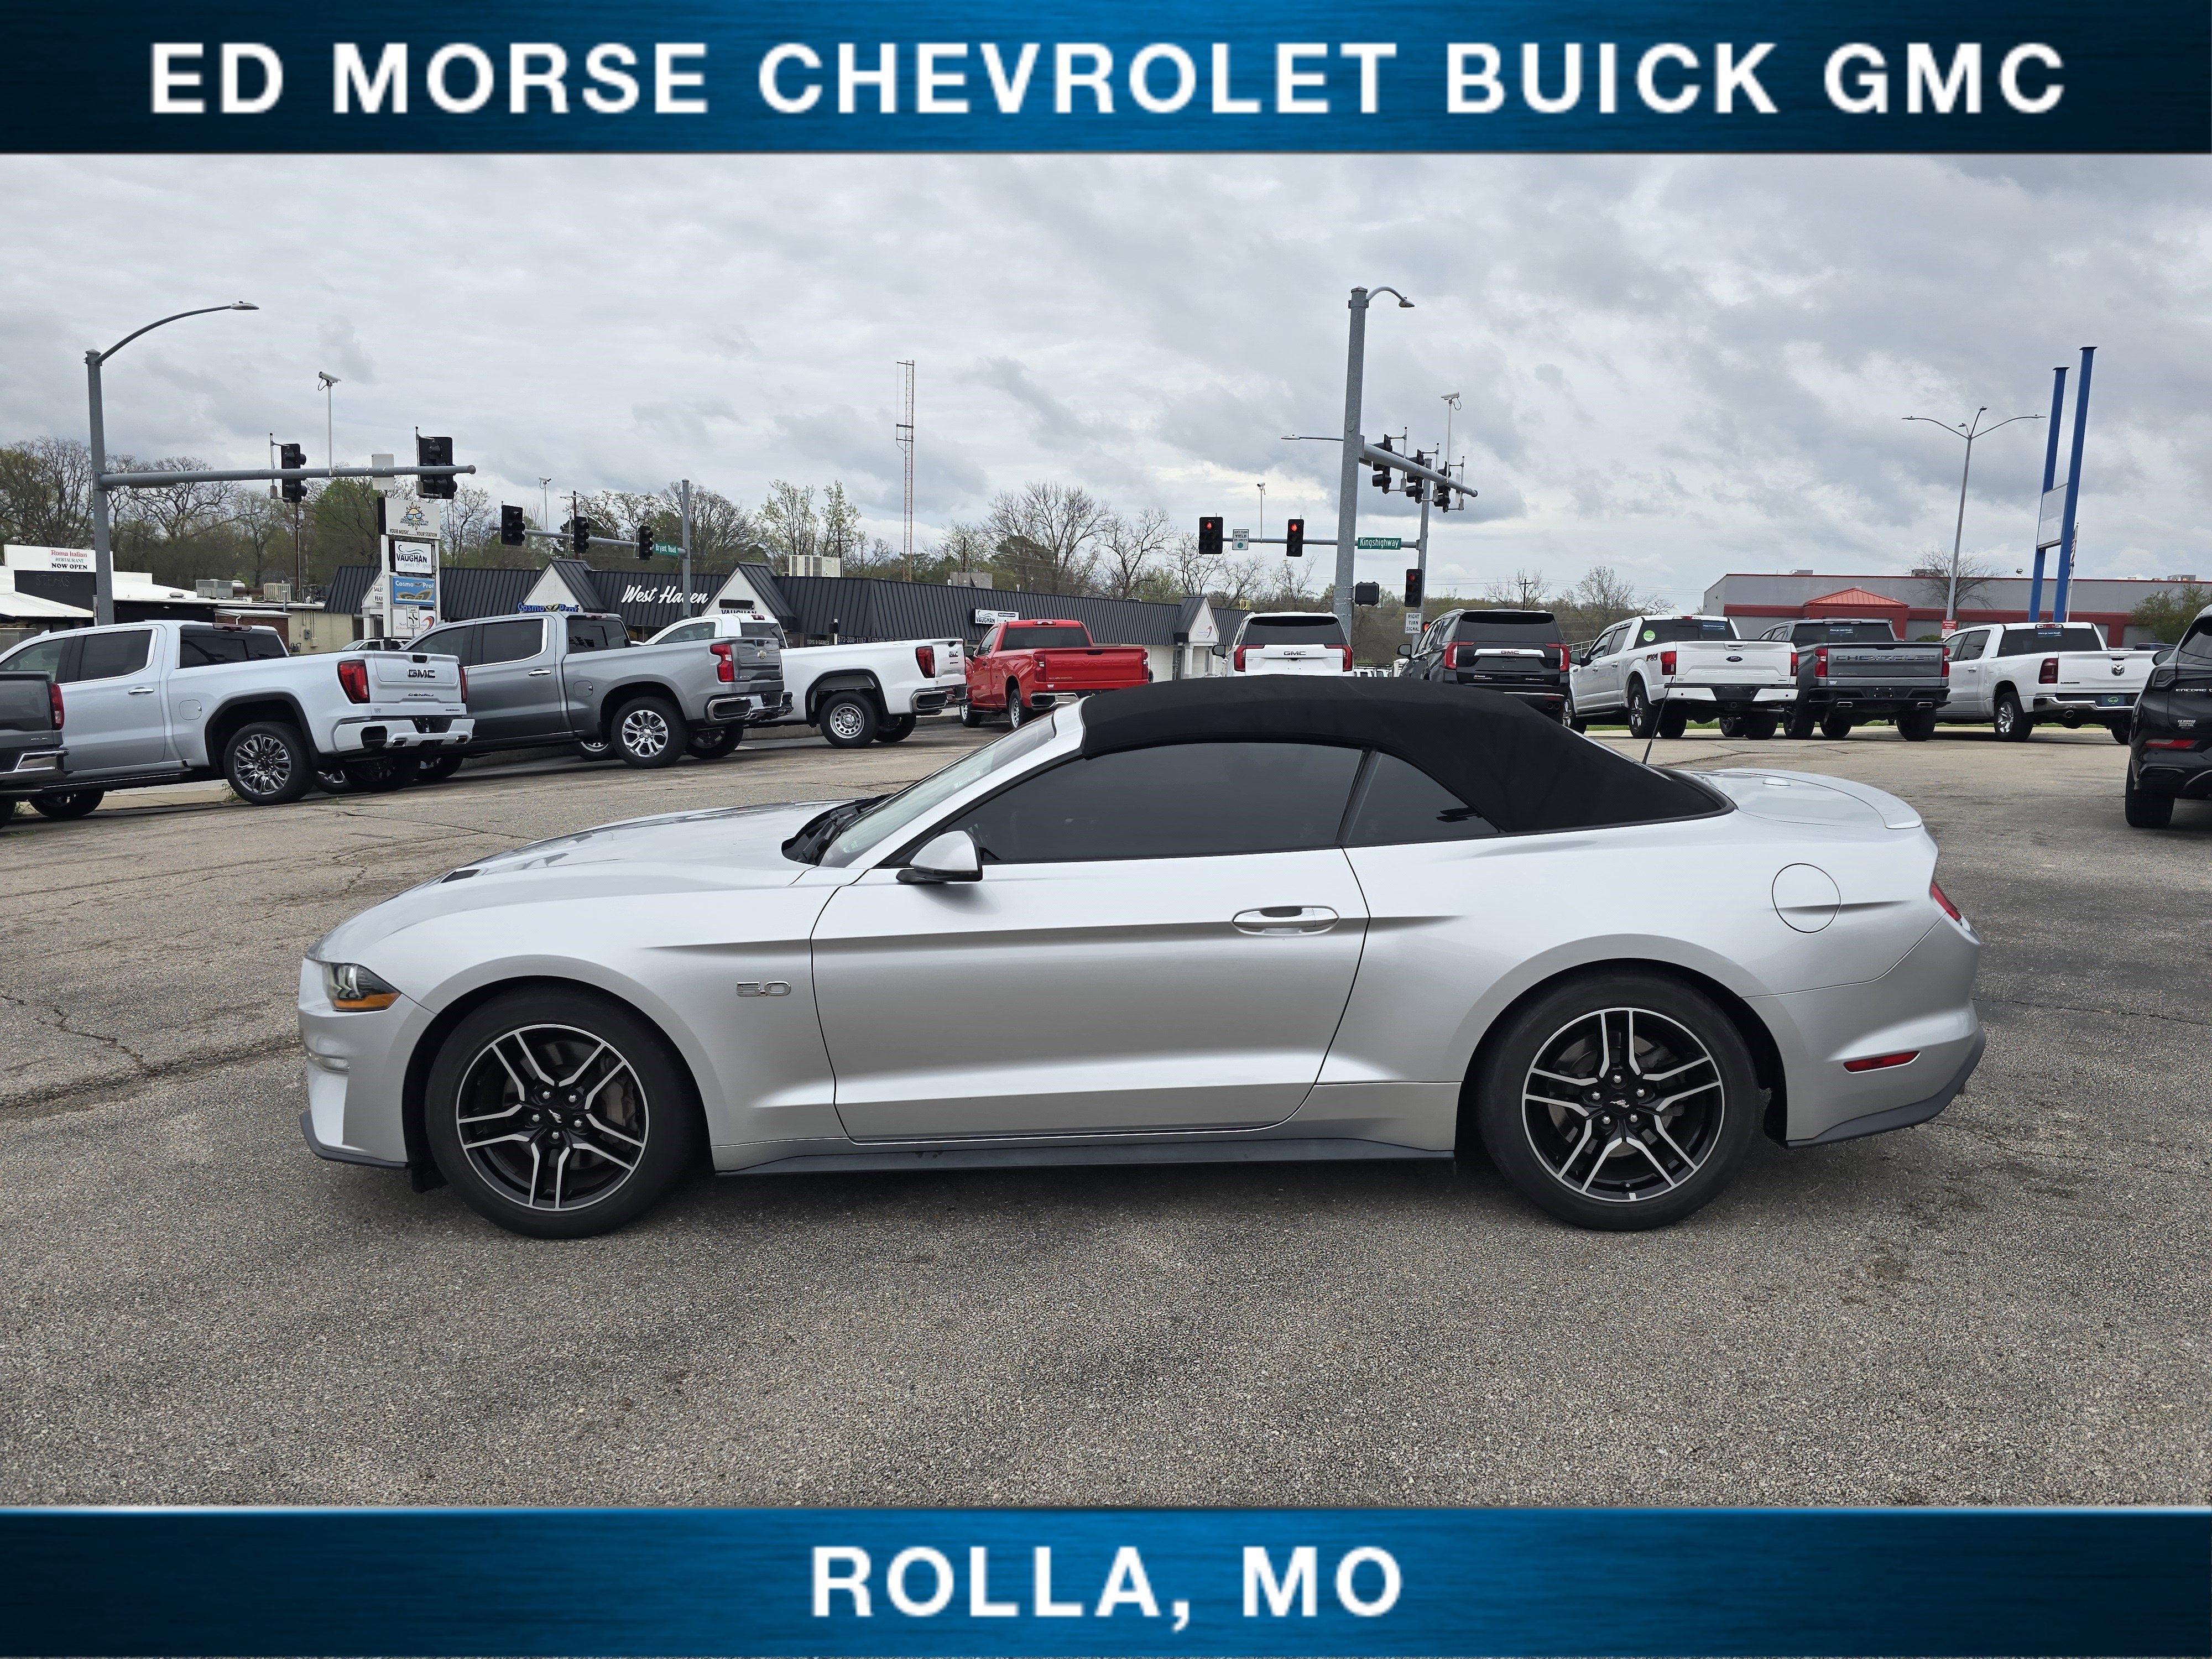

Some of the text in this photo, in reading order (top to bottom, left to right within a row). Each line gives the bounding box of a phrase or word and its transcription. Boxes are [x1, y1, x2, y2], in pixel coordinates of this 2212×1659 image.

[1360, 538, 1399, 549] Kingshighway
[655, 544, 676, 554] Bryant Road
[396, 553, 427, 563] VAUGHAN
[621, 584, 709, 605] West Haen
[518, 602, 544, 612] Cosmo
[1646, 653, 1658, 662] FX4
[407, 669, 436, 679] GMC
[736, 980, 791, 997] 5.0
